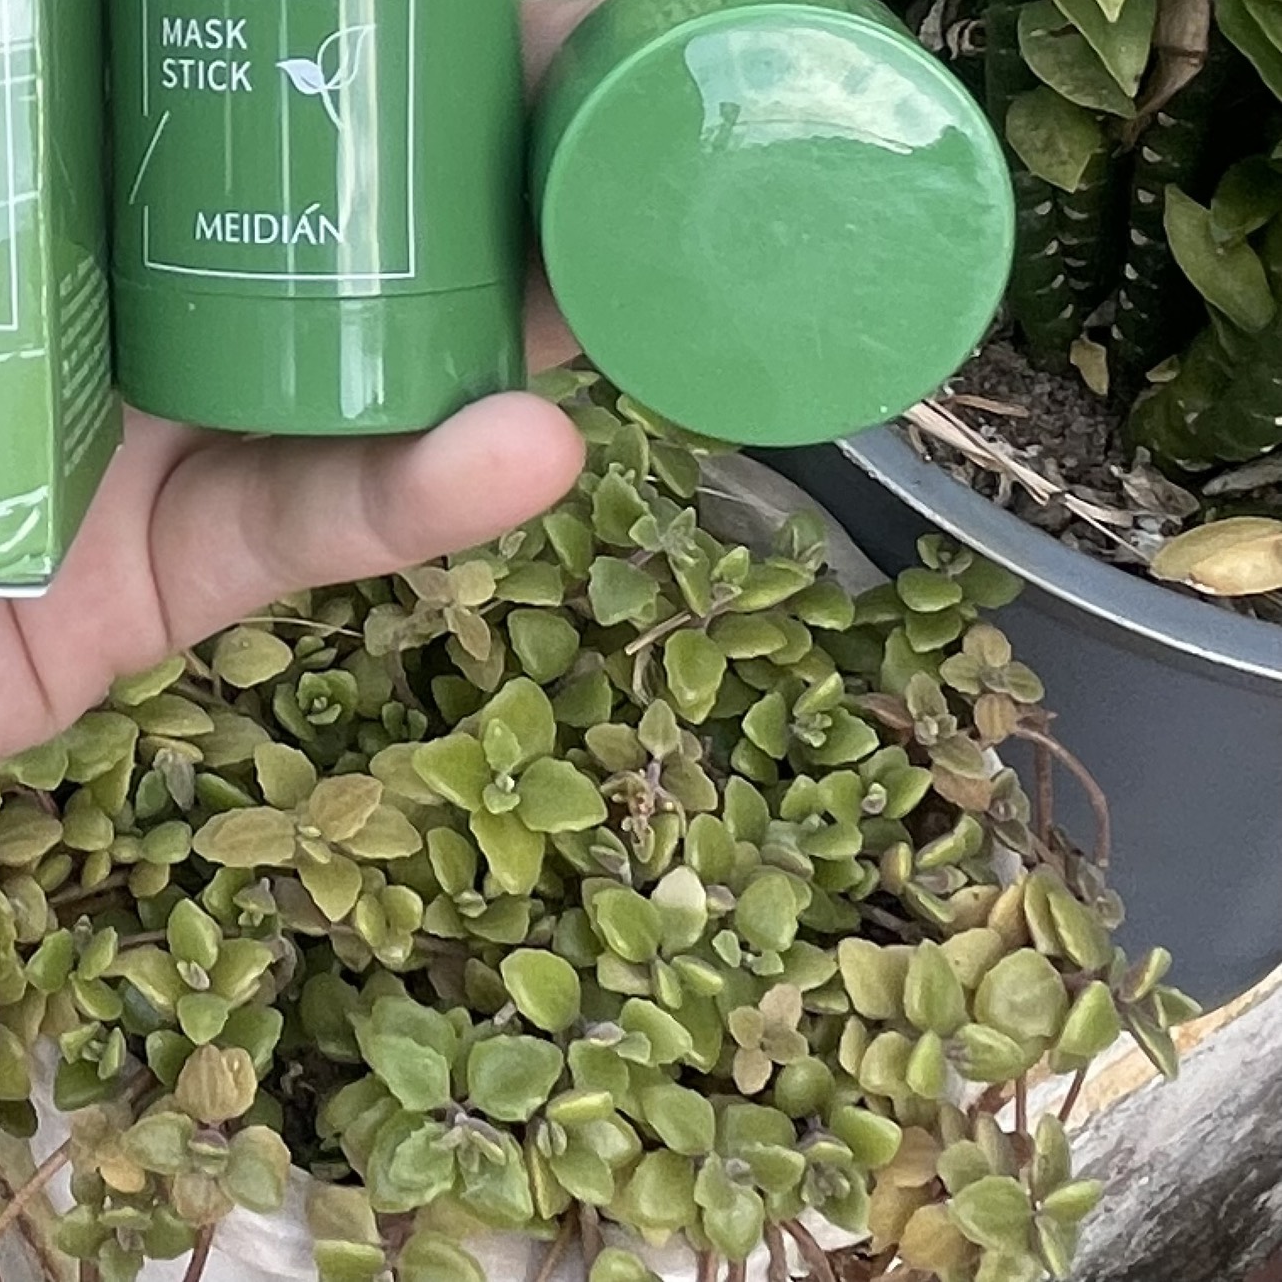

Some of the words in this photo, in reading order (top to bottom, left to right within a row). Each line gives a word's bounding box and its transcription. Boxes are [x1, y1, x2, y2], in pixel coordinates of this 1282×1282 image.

[161, 18, 248, 50] MASK
[161, 59, 252, 91] STICK
[194, 203, 347, 244] MEIDIÁN
